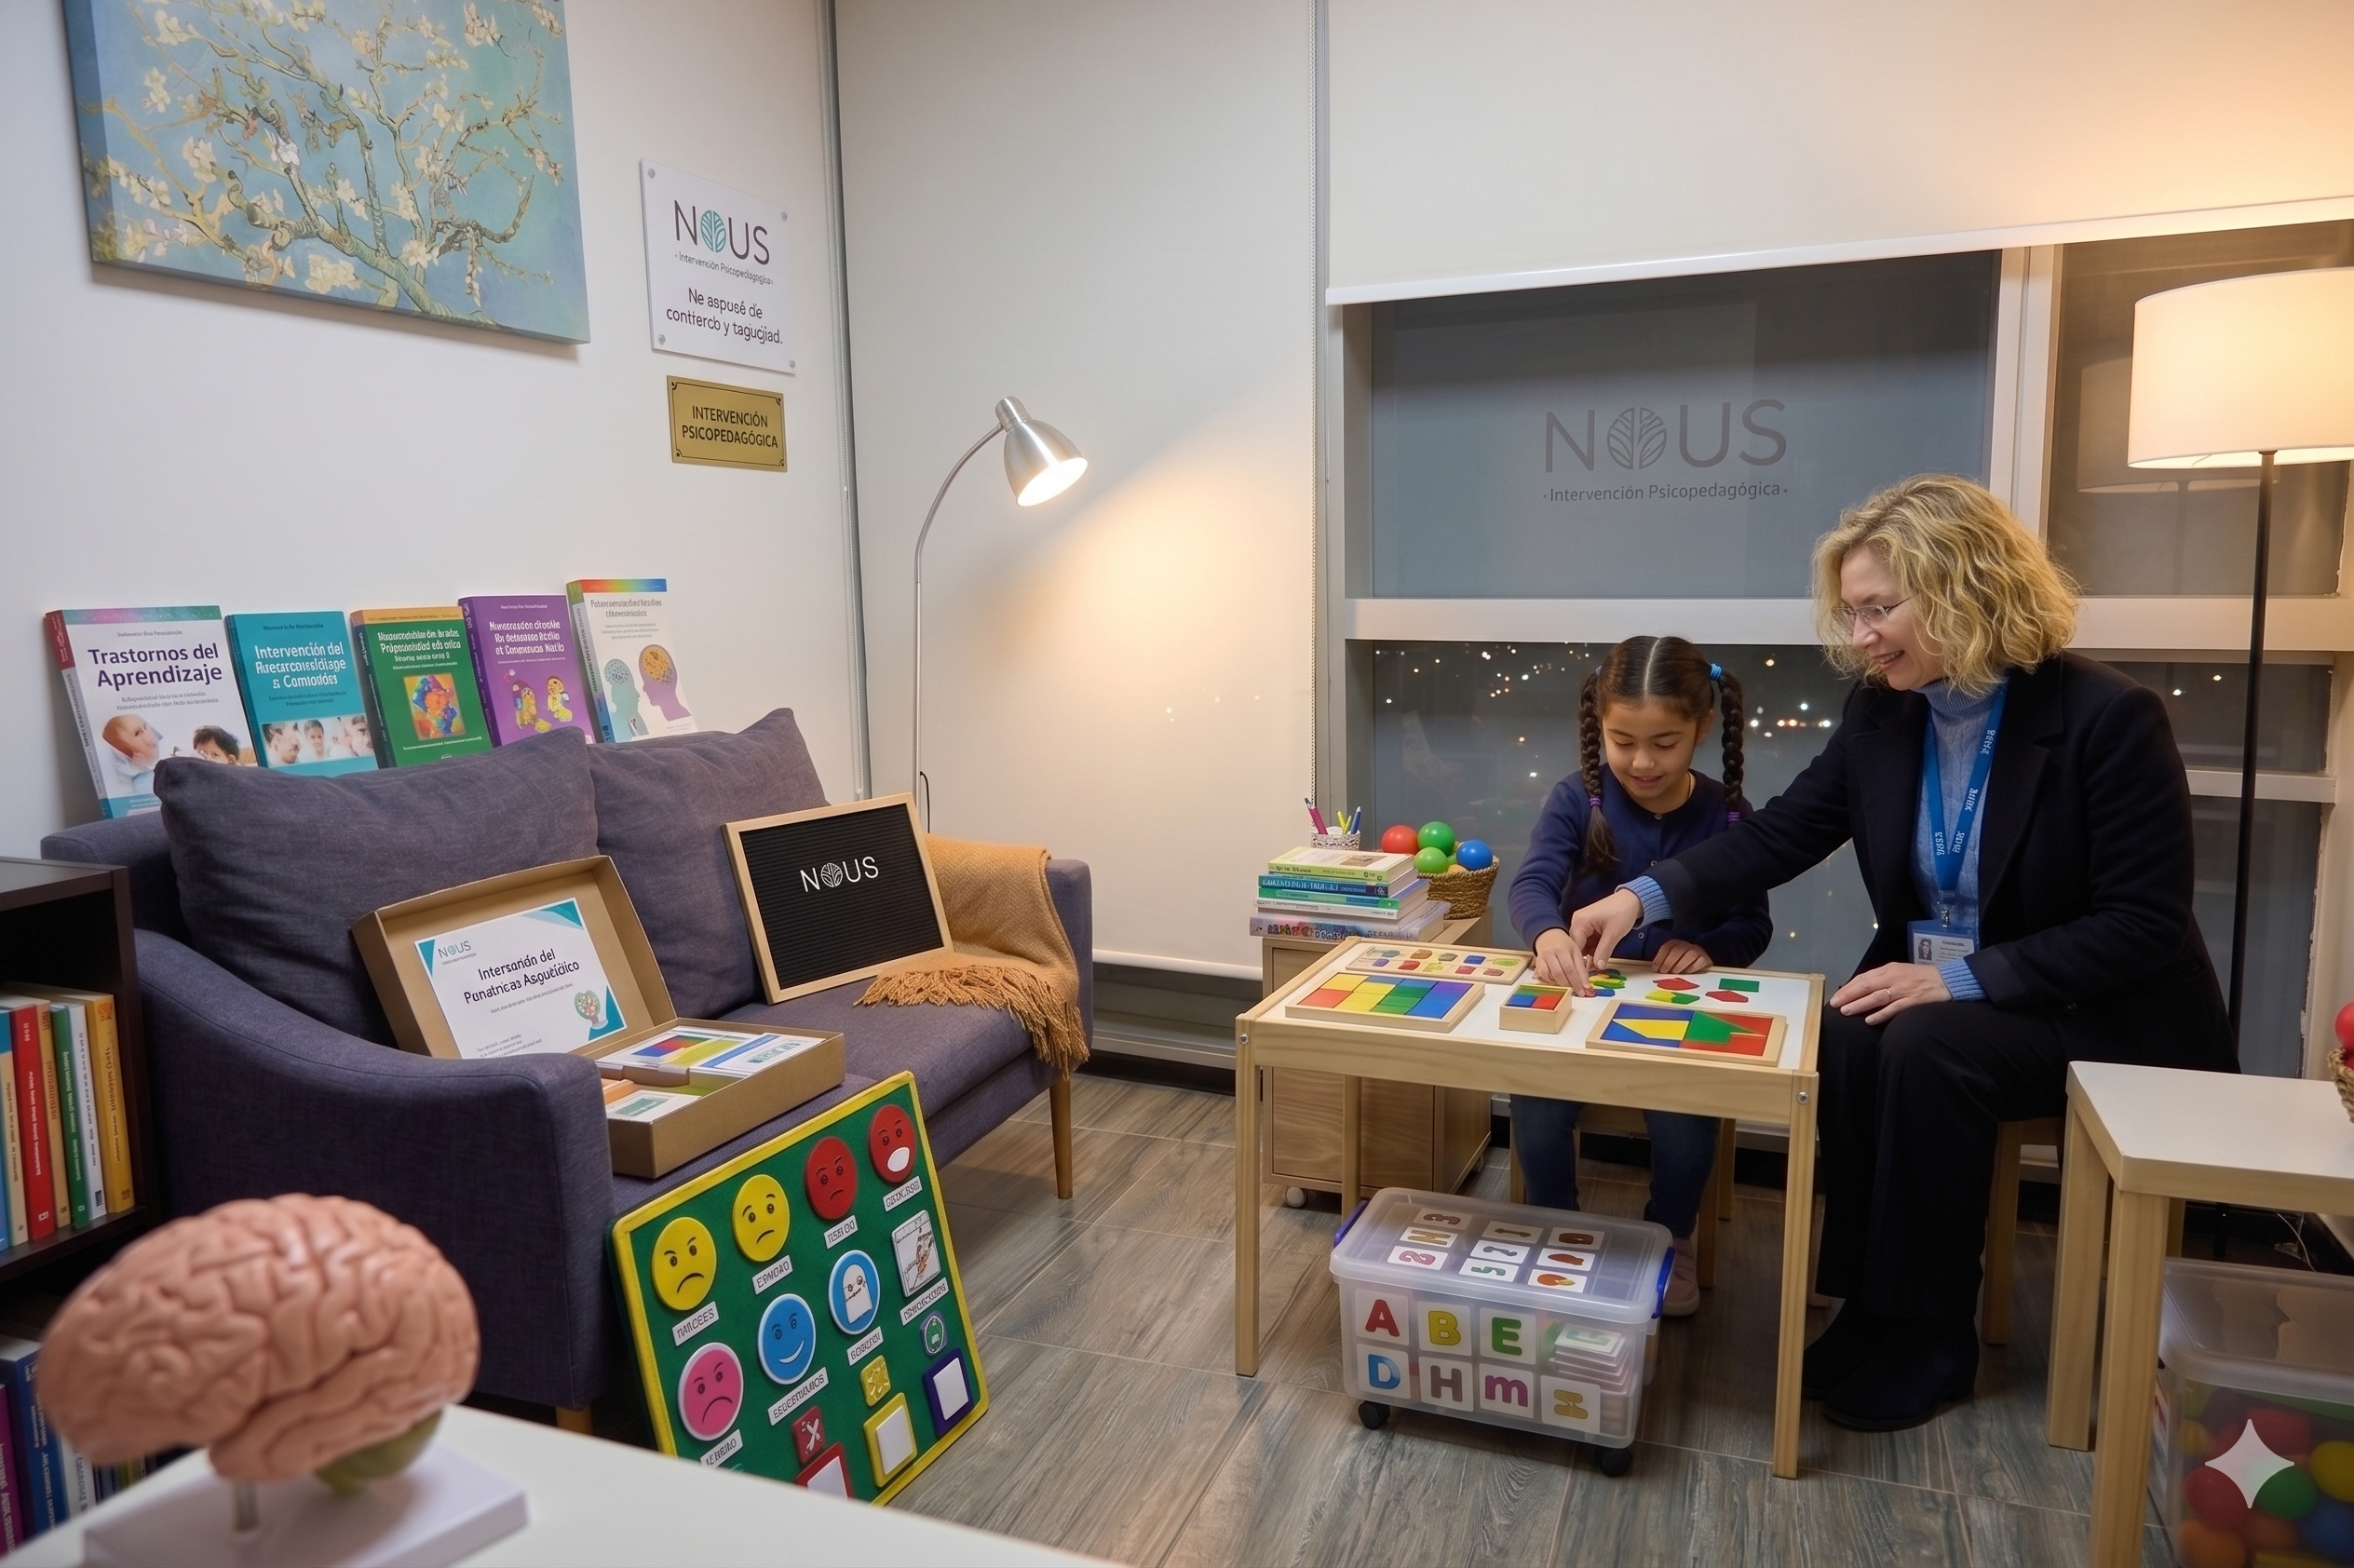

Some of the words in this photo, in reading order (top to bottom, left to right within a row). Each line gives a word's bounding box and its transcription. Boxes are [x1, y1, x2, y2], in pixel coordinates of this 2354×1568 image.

[674, 199, 770, 265] NOUS
[688, 287, 704, 305] Ne
[724, 321, 730, 336] y
[692, 405, 768, 427] INTERVENCIÓN
[682, 425, 778, 448] PSICOPEDAGÓGICA
[1545, 399, 1787, 473] NOUS
[1549, 485, 1644, 502] Intervención
[1648, 481, 1781, 502] Psicopedagógica
[88, 648, 189, 665] Trastornos
[193, 642, 220, 659] del
[254, 642, 326, 659] Intervención
[327, 641, 345, 656] del
[98, 664, 223, 691] Aprendizaje
[800, 856, 879, 893] NOUS
[438, 940, 472, 958] NOUS
[540, 948, 556, 963] del
[1365, 1299, 1400, 1337] A
[1427, 1310, 1461, 1345] B
[1492, 1317, 1522, 1356] E
[1367, 1353, 1400, 1390] D
[1430, 1365, 1463, 1402] H
[1484, 1374, 1528, 1407] m
